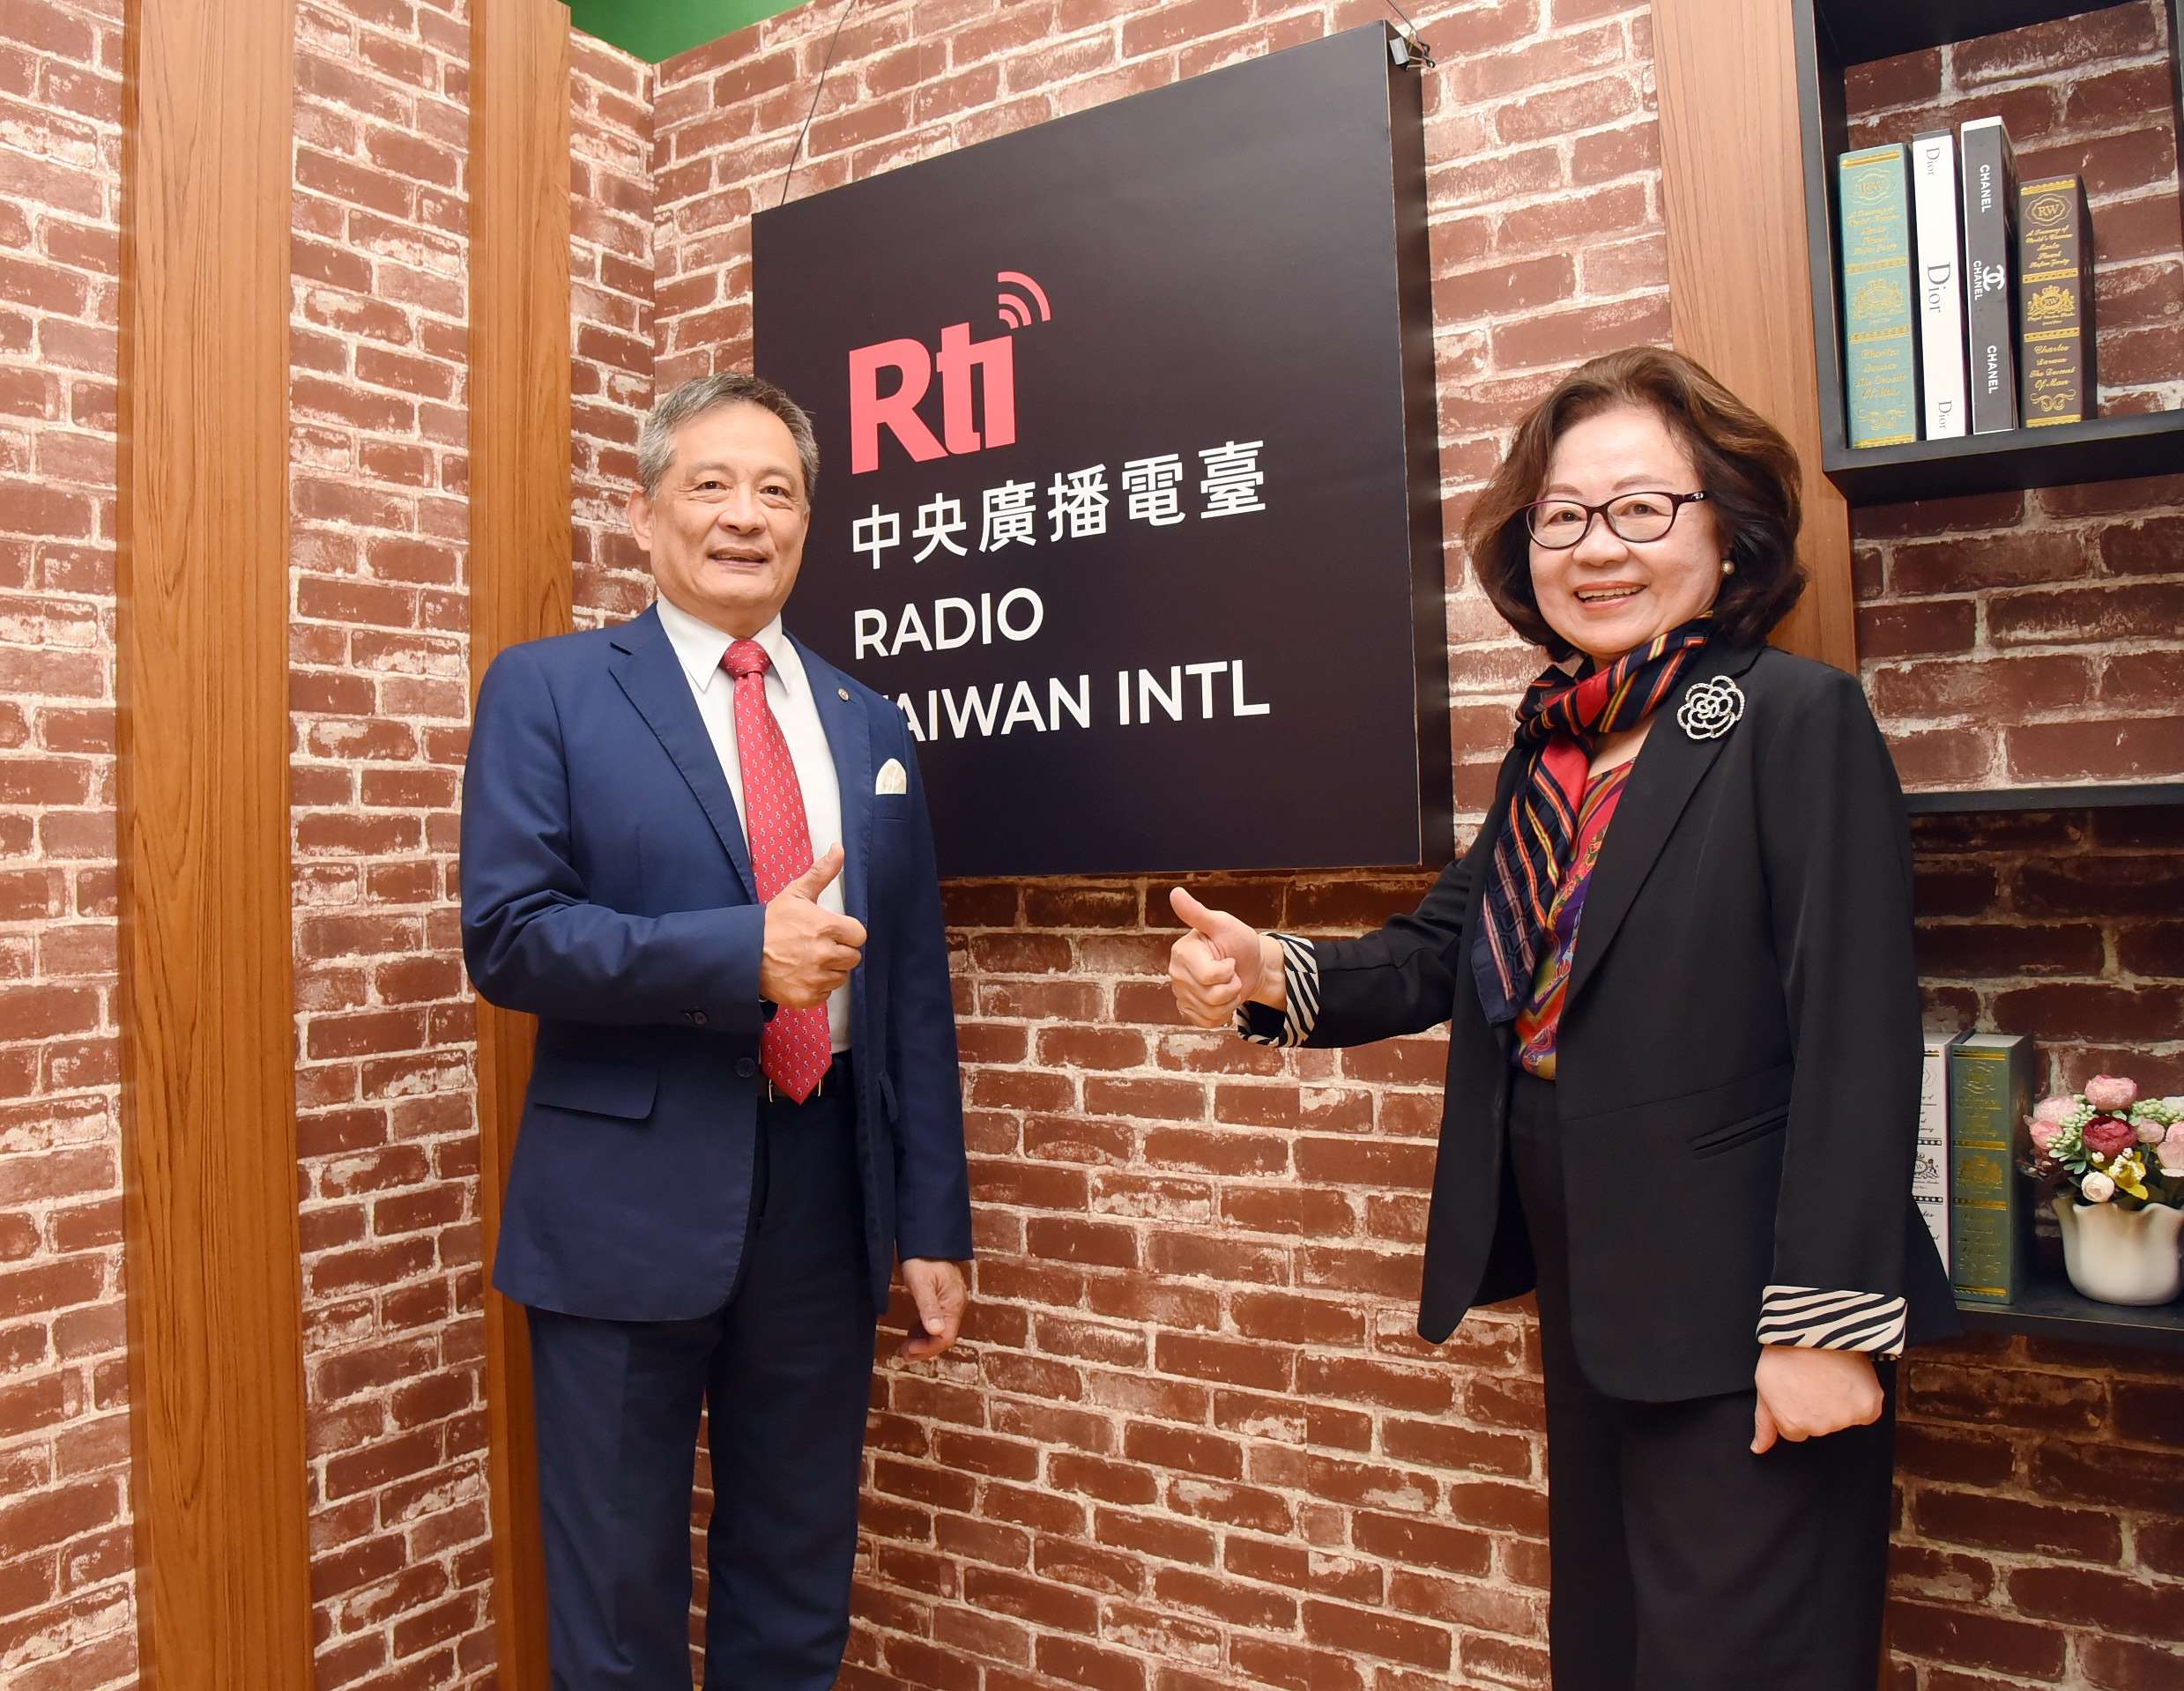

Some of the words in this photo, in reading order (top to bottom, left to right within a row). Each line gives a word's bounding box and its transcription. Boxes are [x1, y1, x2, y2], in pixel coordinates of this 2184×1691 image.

[1926, 147, 1940, 177] Dior
[1980, 164, 1993, 213] CHANEL
[2037, 204, 2060, 217] RW
[1927, 261, 1951, 313] Dior
[1973, 260, 1984, 301] CHANEL
[1987, 345, 2000, 395] CHANEL
[849, 321, 1016, 475] Rti
[1938, 400, 1952, 430] Dior
[852, 441, 1267, 570] 中央廣播電臺
[854, 587, 1044, 660] RADIO
[881, 674, 1091, 743] AIWAN
[1118, 659, 1271, 725] INTL
